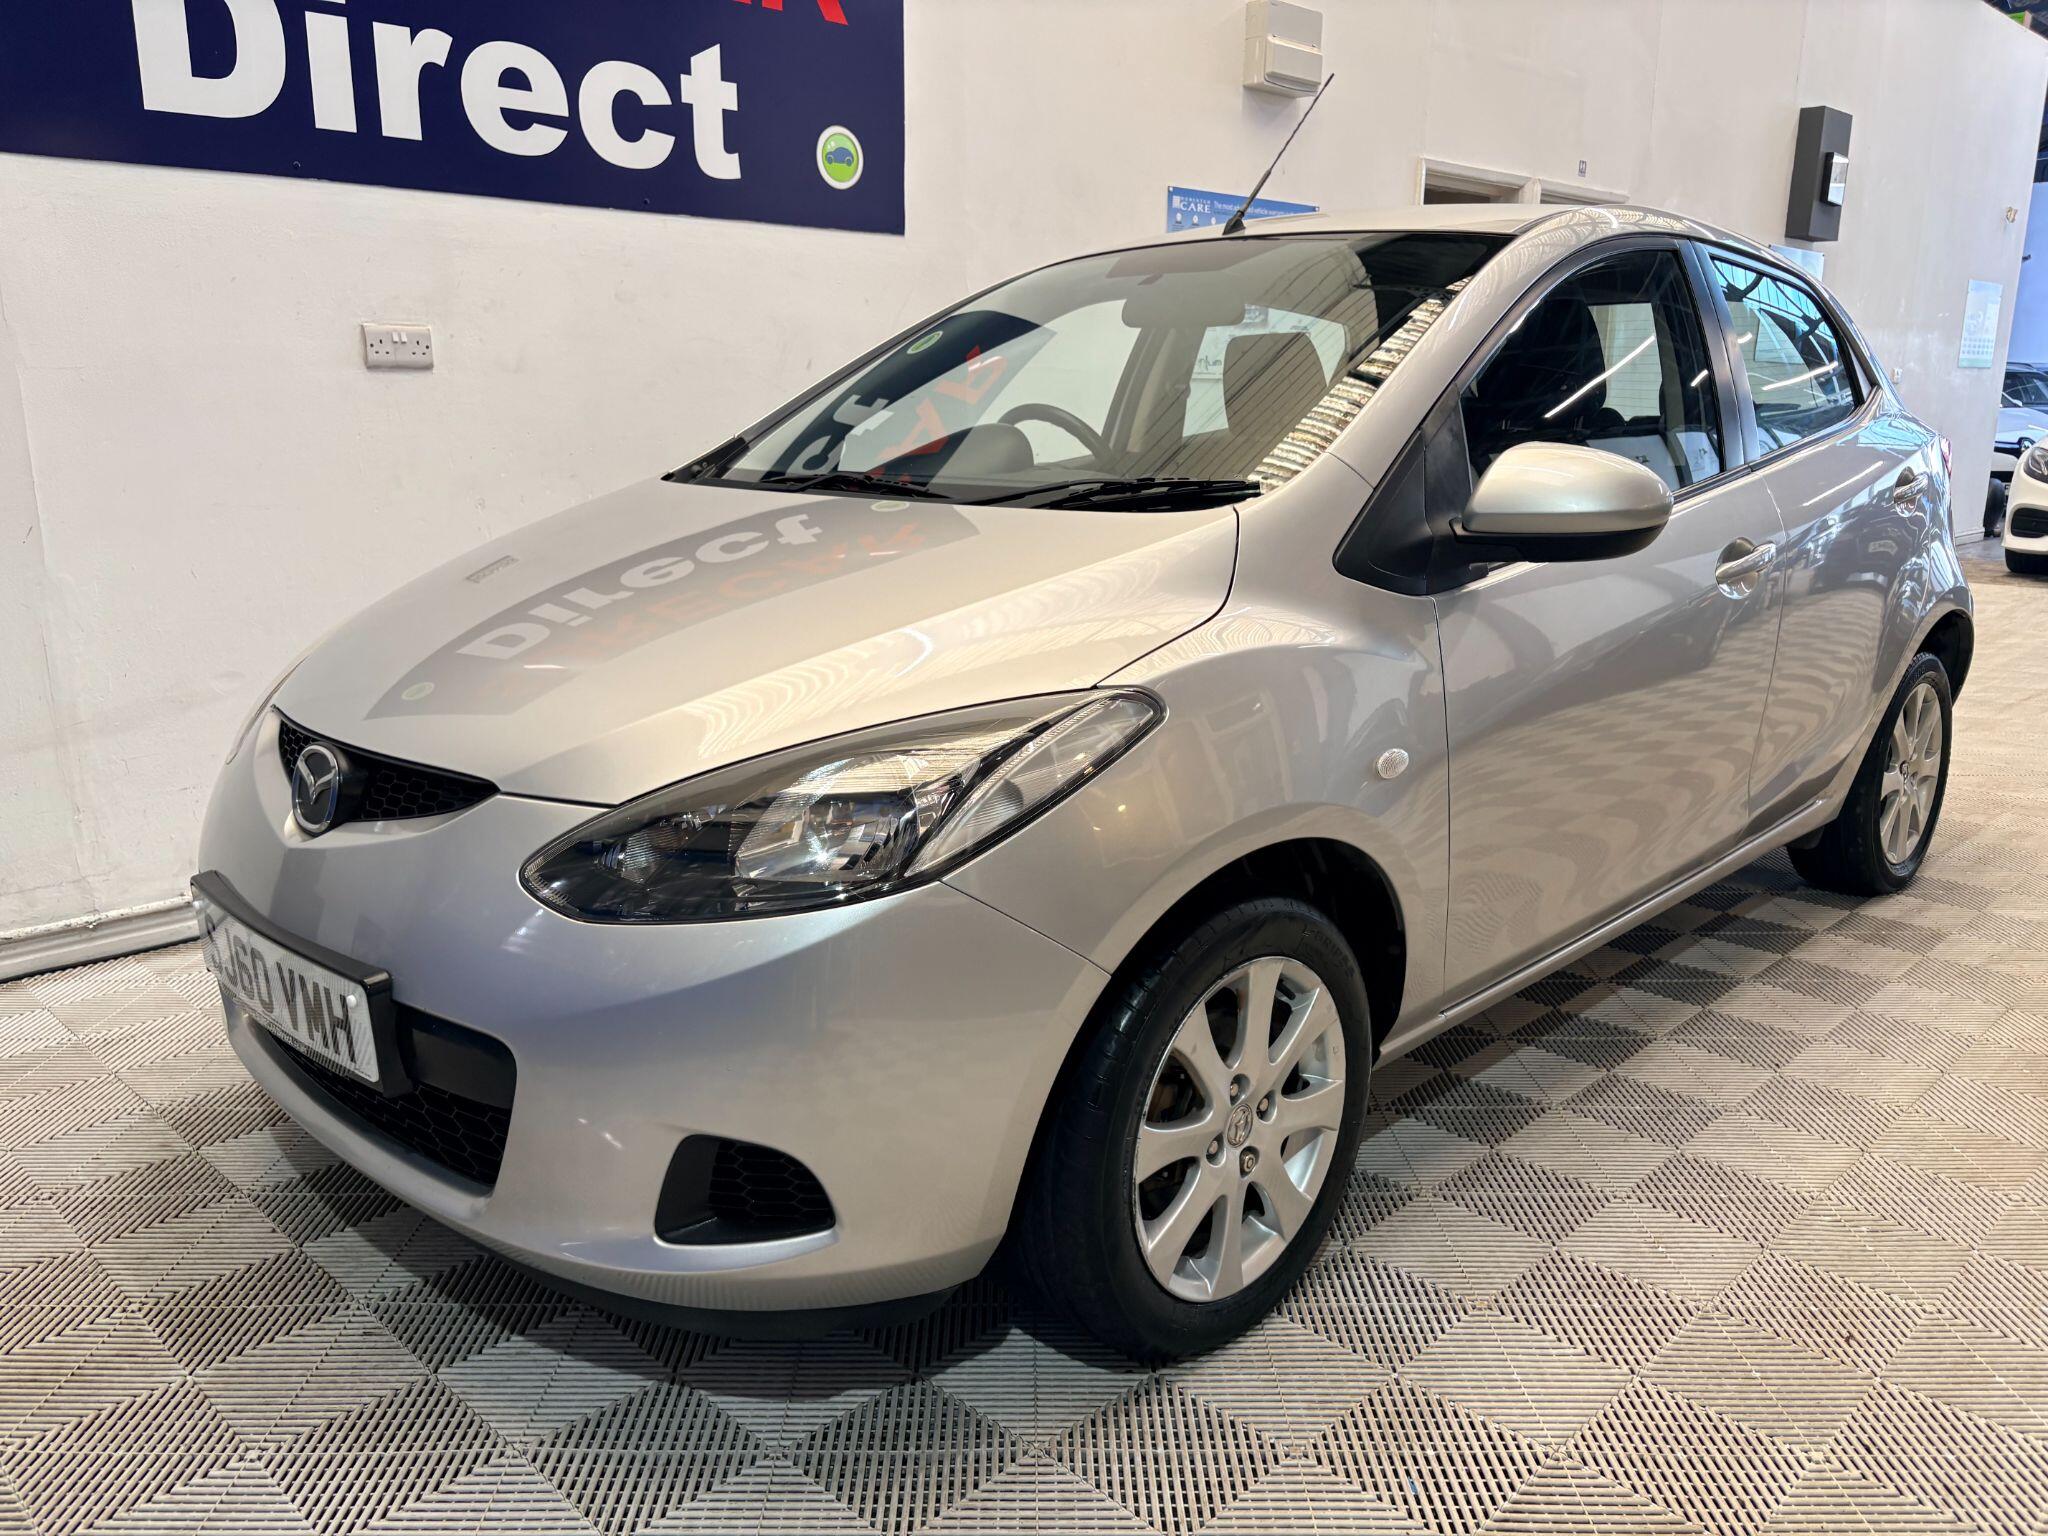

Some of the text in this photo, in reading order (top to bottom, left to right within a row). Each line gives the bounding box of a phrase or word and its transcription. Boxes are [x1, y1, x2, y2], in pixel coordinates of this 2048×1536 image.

[132, 0, 741, 179] Direct
[1180, 201, 1211, 213] CARE
[276, 961, 357, 1064] VMH
